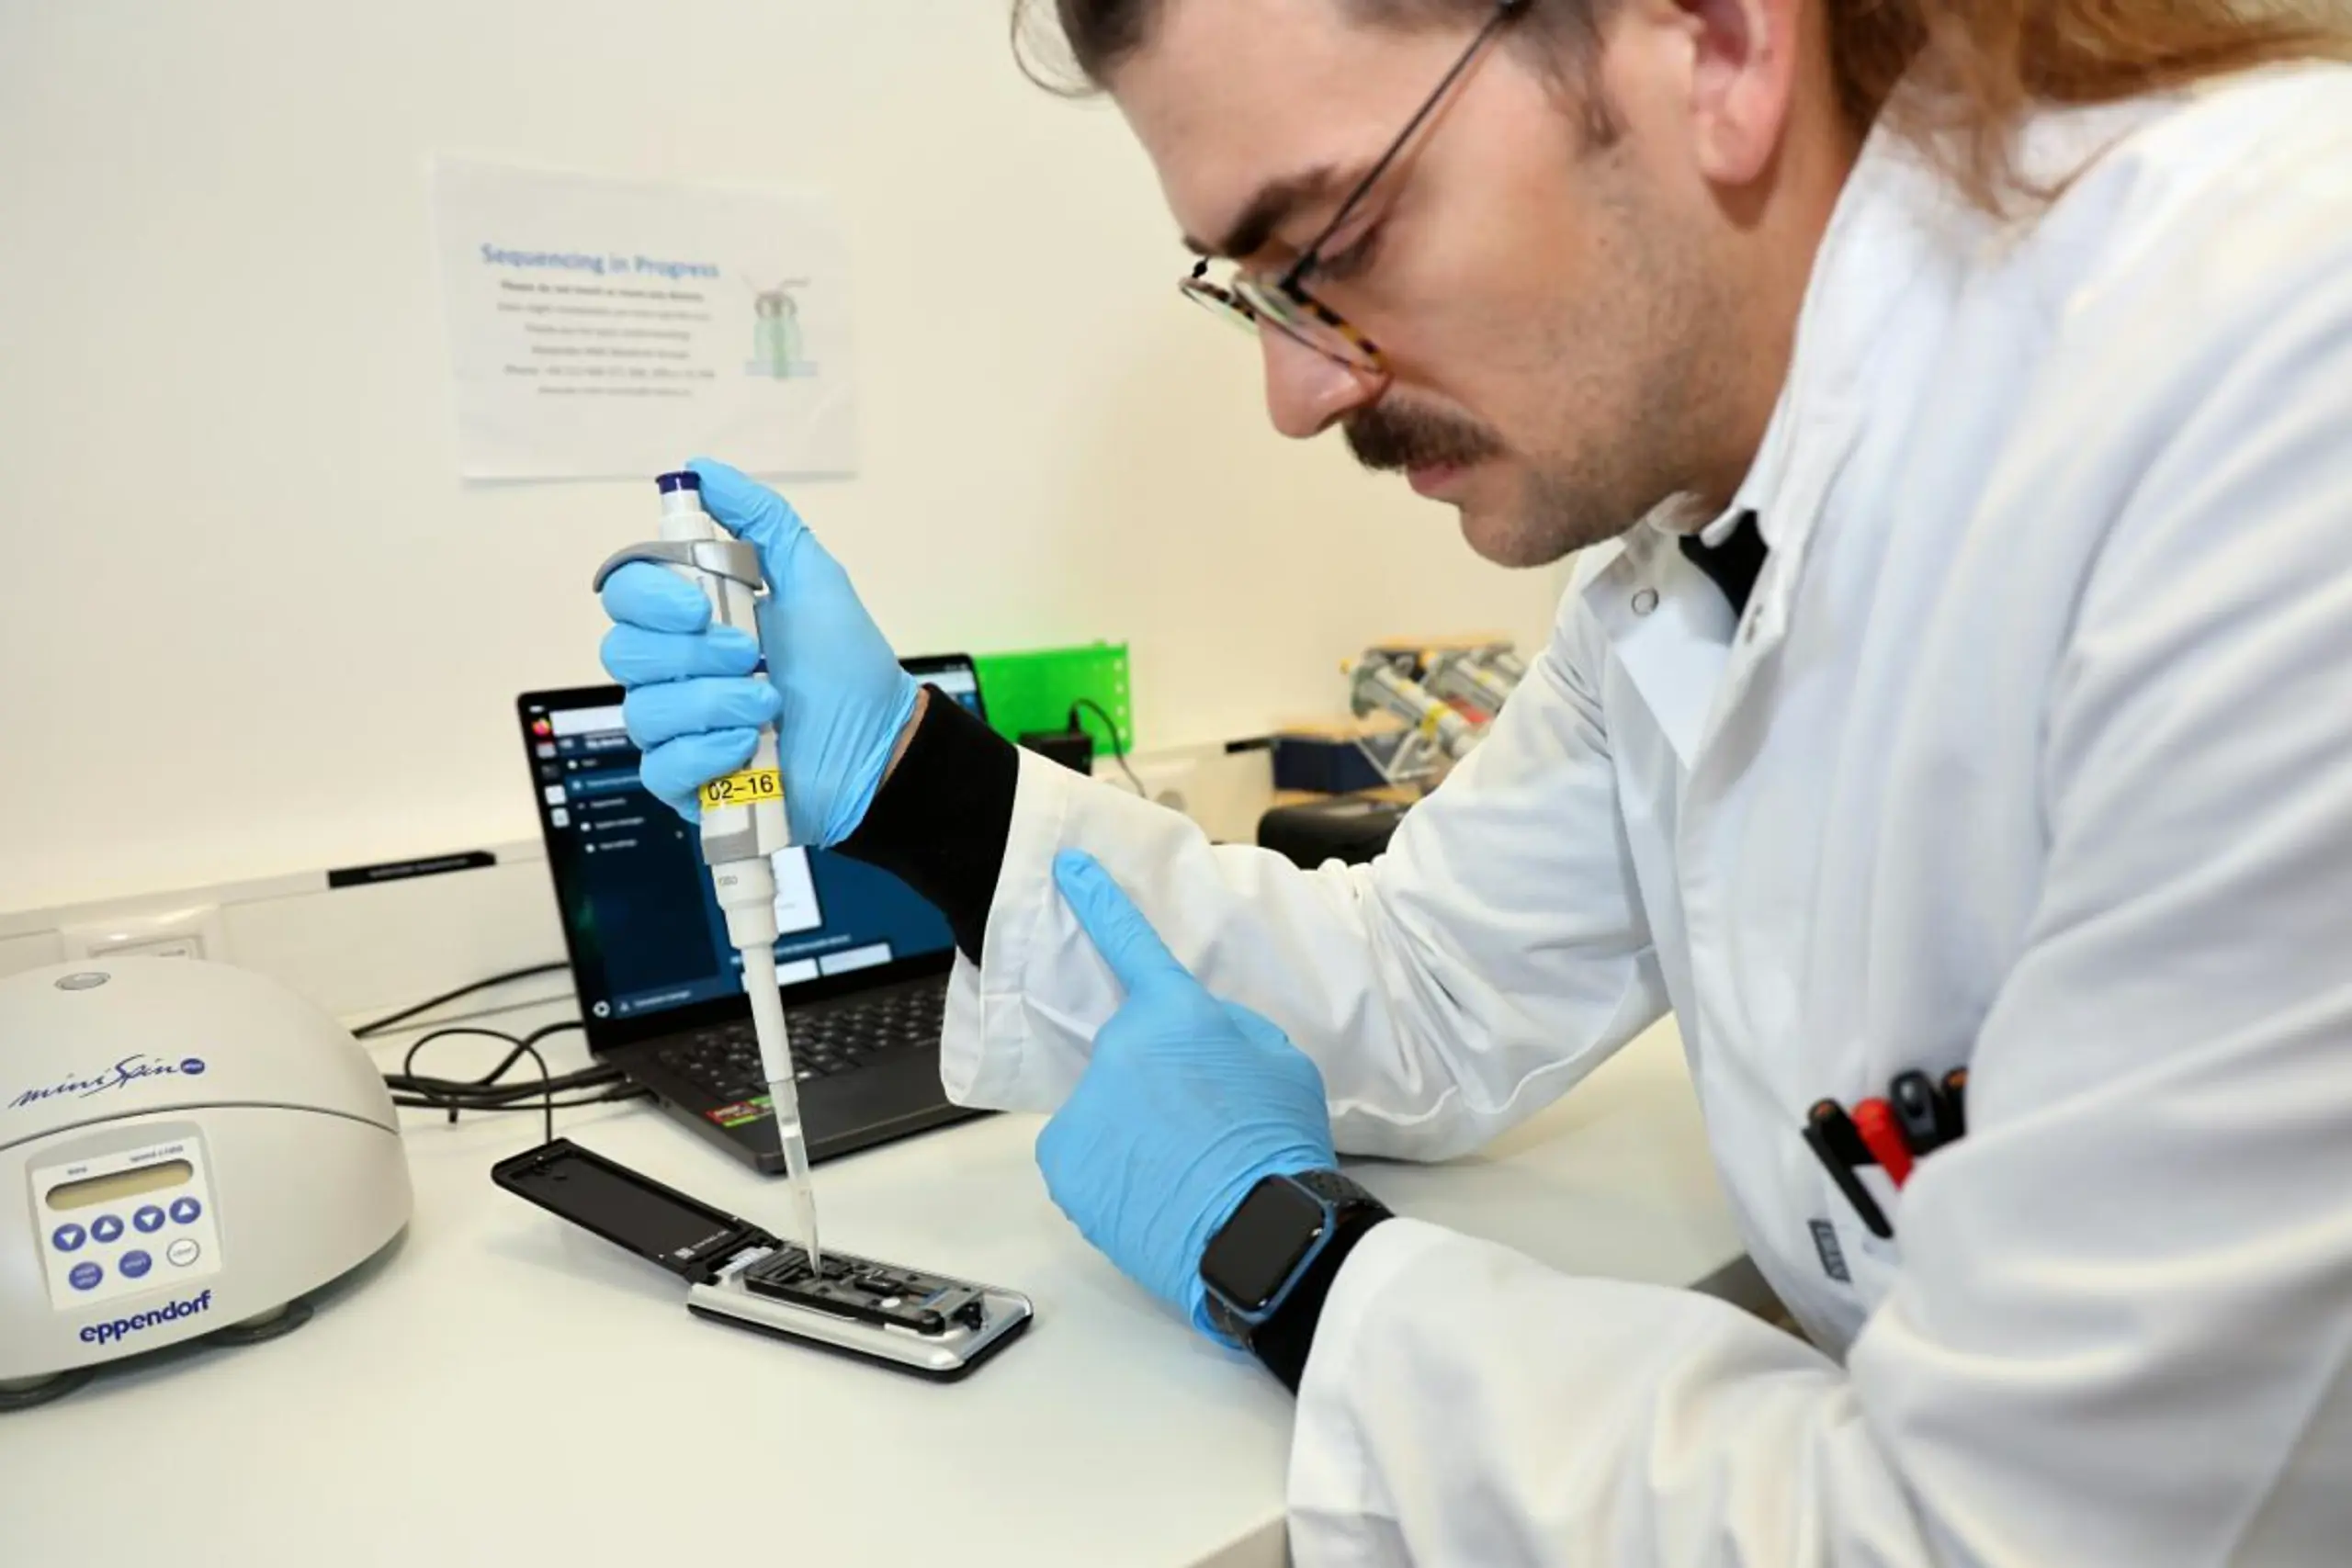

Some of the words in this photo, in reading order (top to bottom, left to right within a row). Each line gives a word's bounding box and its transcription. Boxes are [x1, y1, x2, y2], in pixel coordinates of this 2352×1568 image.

[481, 242, 605, 276] Sequencing
[609, 253, 629, 274] in
[634, 254, 719, 281] Progress
[707, 774, 774, 801] 02-16
[80, 1290, 210, 1345] eppendorf
